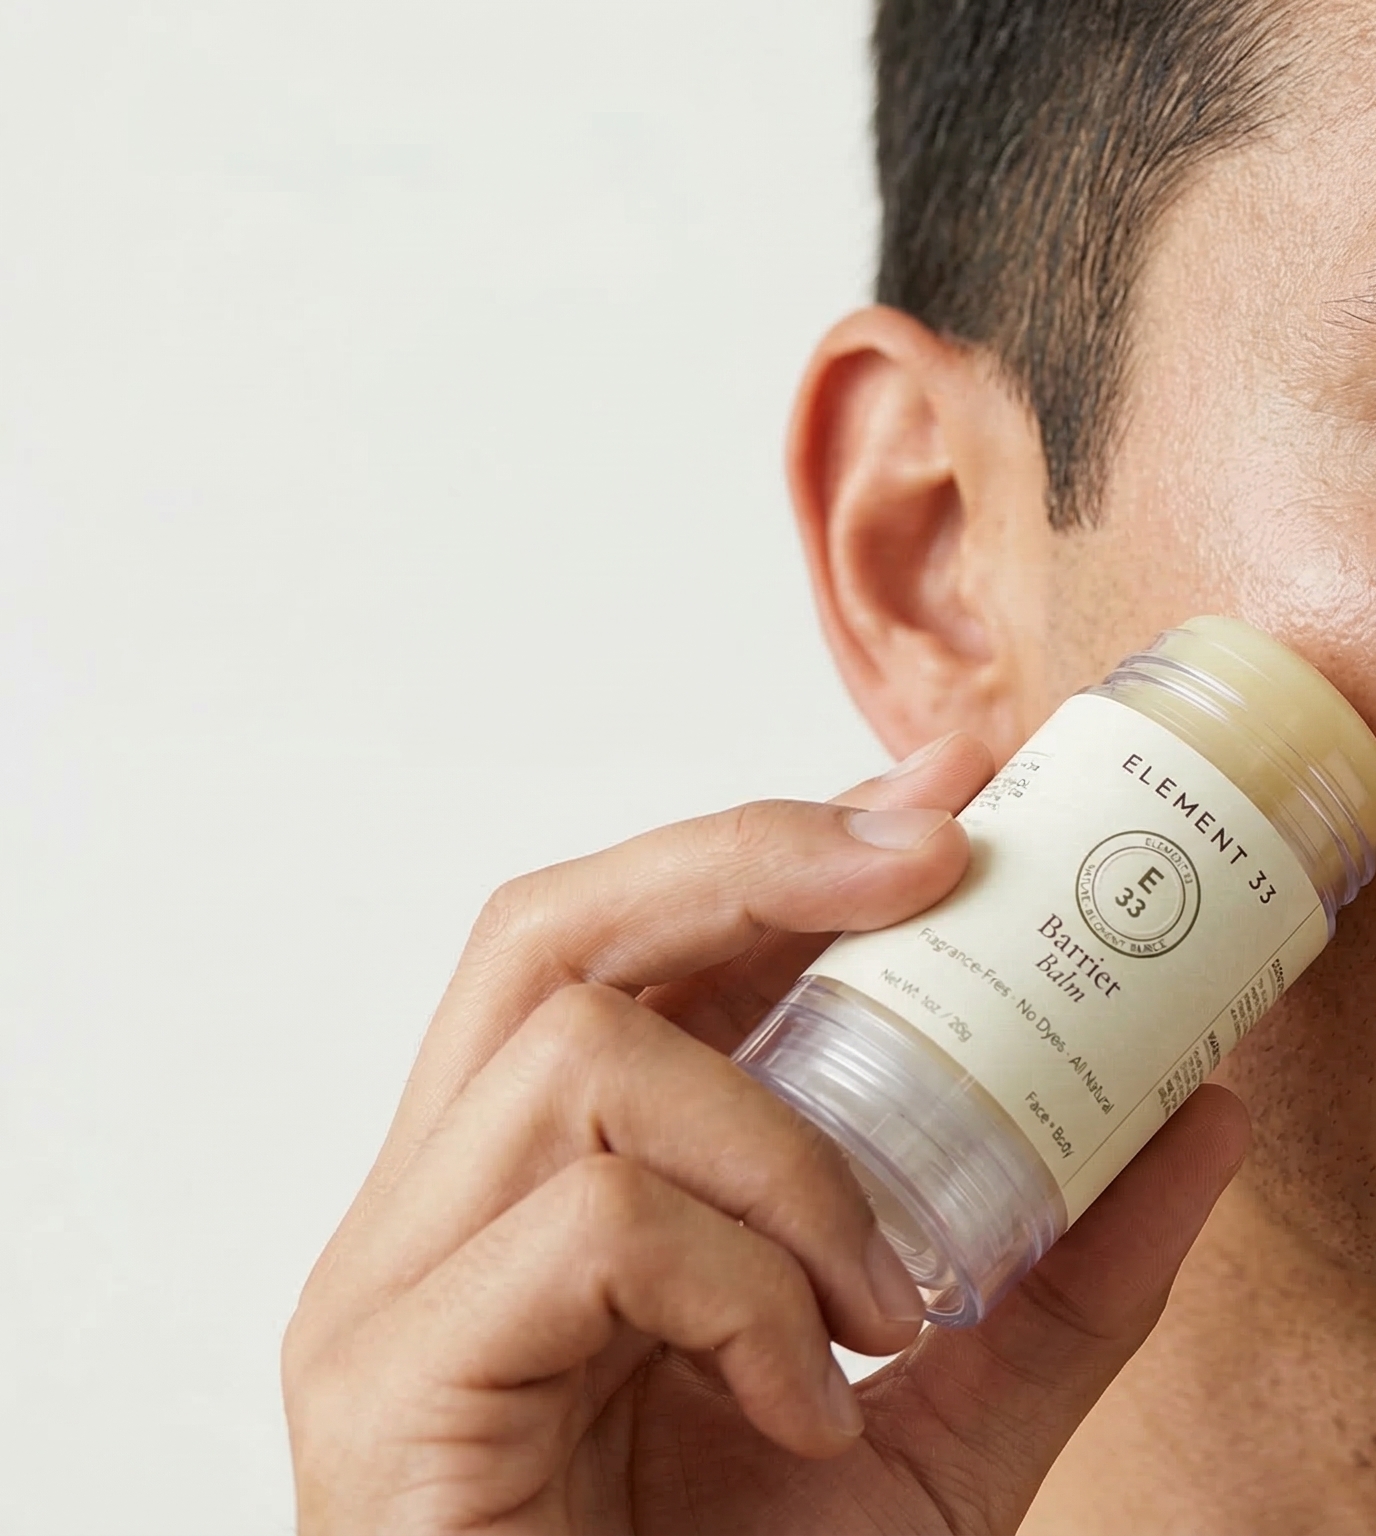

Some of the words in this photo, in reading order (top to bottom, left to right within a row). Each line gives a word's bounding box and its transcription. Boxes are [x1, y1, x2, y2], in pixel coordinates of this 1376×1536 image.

[1122, 753, 1248, 865] ELEMENT
[1248, 869, 1277, 904] 33
[1137, 866, 1165, 895] E
[1115, 887, 1147, 918] 33
[1035, 953, 1085, 1003] Balm
[1016, 998, 1037, 1021] No
[1035, 1016, 1066, 1053] Dyes
[1068, 1056, 1088, 1075] All
[1082, 1070, 1115, 1115] Natural
[1025, 1091, 1050, 1124] Face
